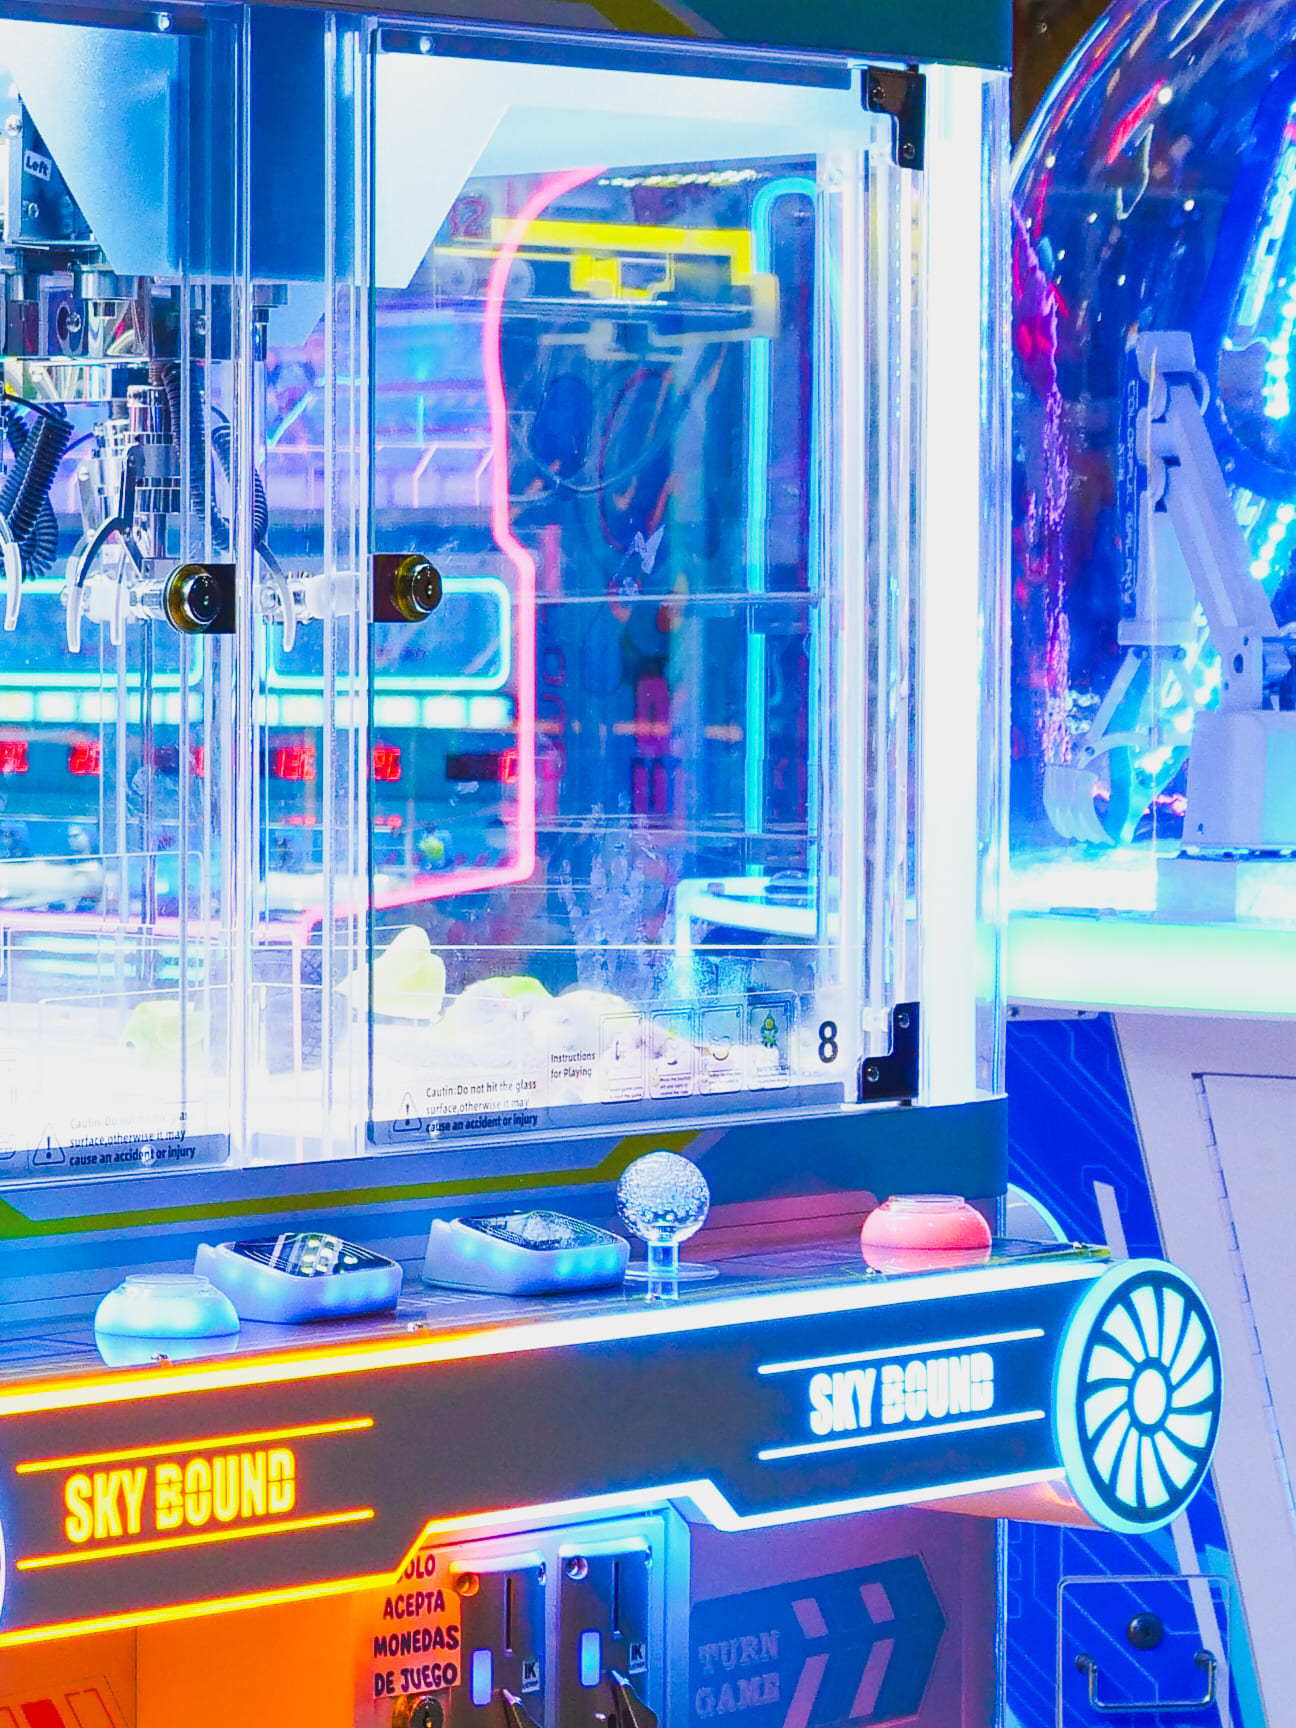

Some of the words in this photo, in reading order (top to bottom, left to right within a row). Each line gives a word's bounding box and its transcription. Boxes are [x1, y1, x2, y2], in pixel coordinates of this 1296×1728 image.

[26, 156, 48, 176] Left
[818, 1020, 838, 1063] 8
[551, 1052, 596, 1064] Instructions
[551, 1069, 561, 1079] for
[563, 1067, 592, 1079] Playing
[470, 1083, 485, 1094] not
[487, 1081, 497, 1093] hit
[499, 1080, 513, 1092] the
[515, 1079, 537, 1093] glass
[512, 1098, 529, 1111] may
[426, 1121, 450, 1134] cause
[452, 1120, 464, 1131] an
[465, 1115, 501, 1129] accident
[503, 1115, 512, 1127] or
[513, 1113, 538, 1128] injury
[165, 1128, 186, 1143] may
[69, 1154, 98, 1167] cause
[99, 1153, 112, 1165] an
[113, 1147, 155, 1163] accident
[156, 1148, 166, 1160] or
[167, 1144, 196, 1161] injury
[809, 1367, 877, 1436] SKY
[881, 1352, 995, 1421] BOUND
[64, 1466, 148, 1544] SKY
[155, 1447, 297, 1532] BOUND
[404, 1553, 436, 1580] OLO
[383, 1589, 446, 1620] ACEPTA
[374, 1624, 460, 1658] MONEDAS
[632, 1643, 643, 1661] IK
[698, 1629, 780, 1675] TURN
[374, 1670, 396, 1697] DE
[400, 1662, 458, 1693] JUEGO
[524, 1662, 536, 1679] IK
[695, 1672, 780, 1719] GAME
